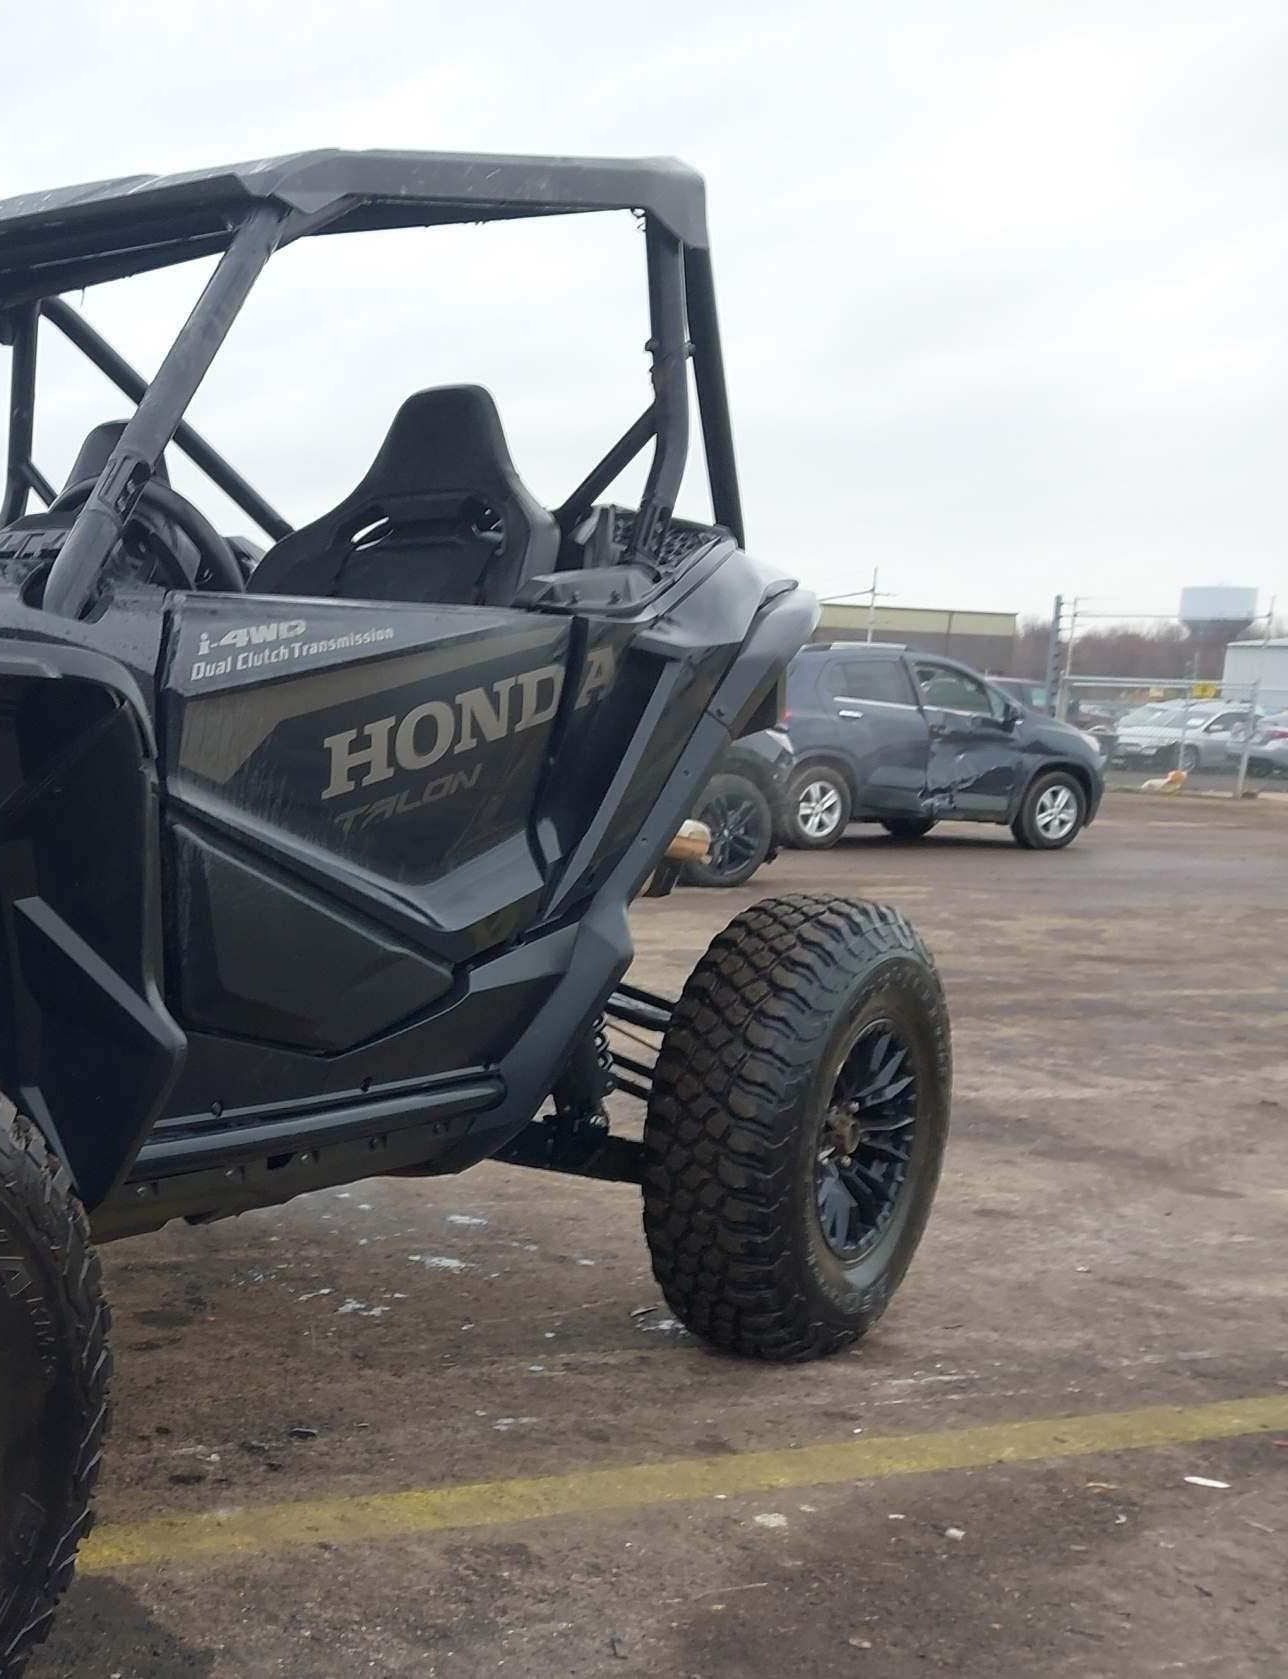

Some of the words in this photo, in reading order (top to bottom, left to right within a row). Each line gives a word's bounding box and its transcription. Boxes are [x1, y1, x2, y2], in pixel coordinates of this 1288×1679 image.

[191, 656, 233, 681] Dual
[236, 647, 290, 671] Clutch
[290, 626, 395, 659] Transmission
[198, 618, 307, 656] i-4WD
[321, 647, 615, 800] HONDA
[334, 763, 483, 833] TALON
